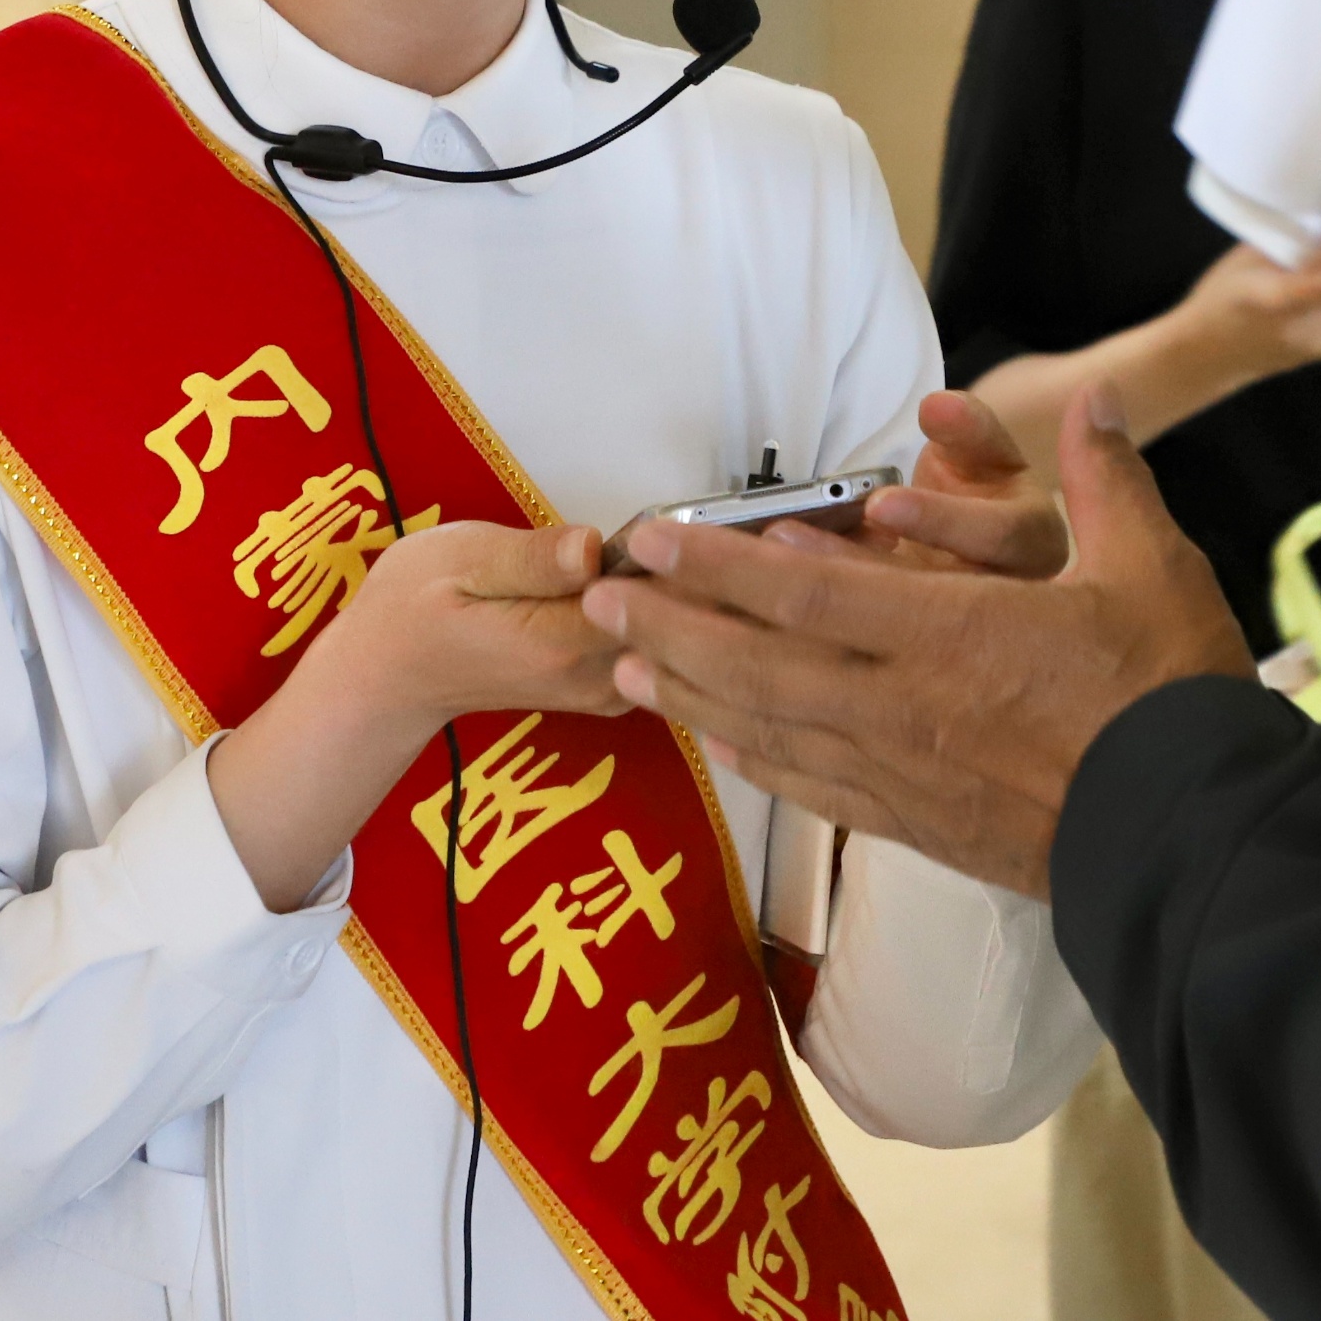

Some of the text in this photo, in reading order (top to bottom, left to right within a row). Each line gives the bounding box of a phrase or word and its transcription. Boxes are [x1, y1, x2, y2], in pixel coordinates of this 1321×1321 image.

[145, 344, 909, 1321] 内蒙医科大学附
